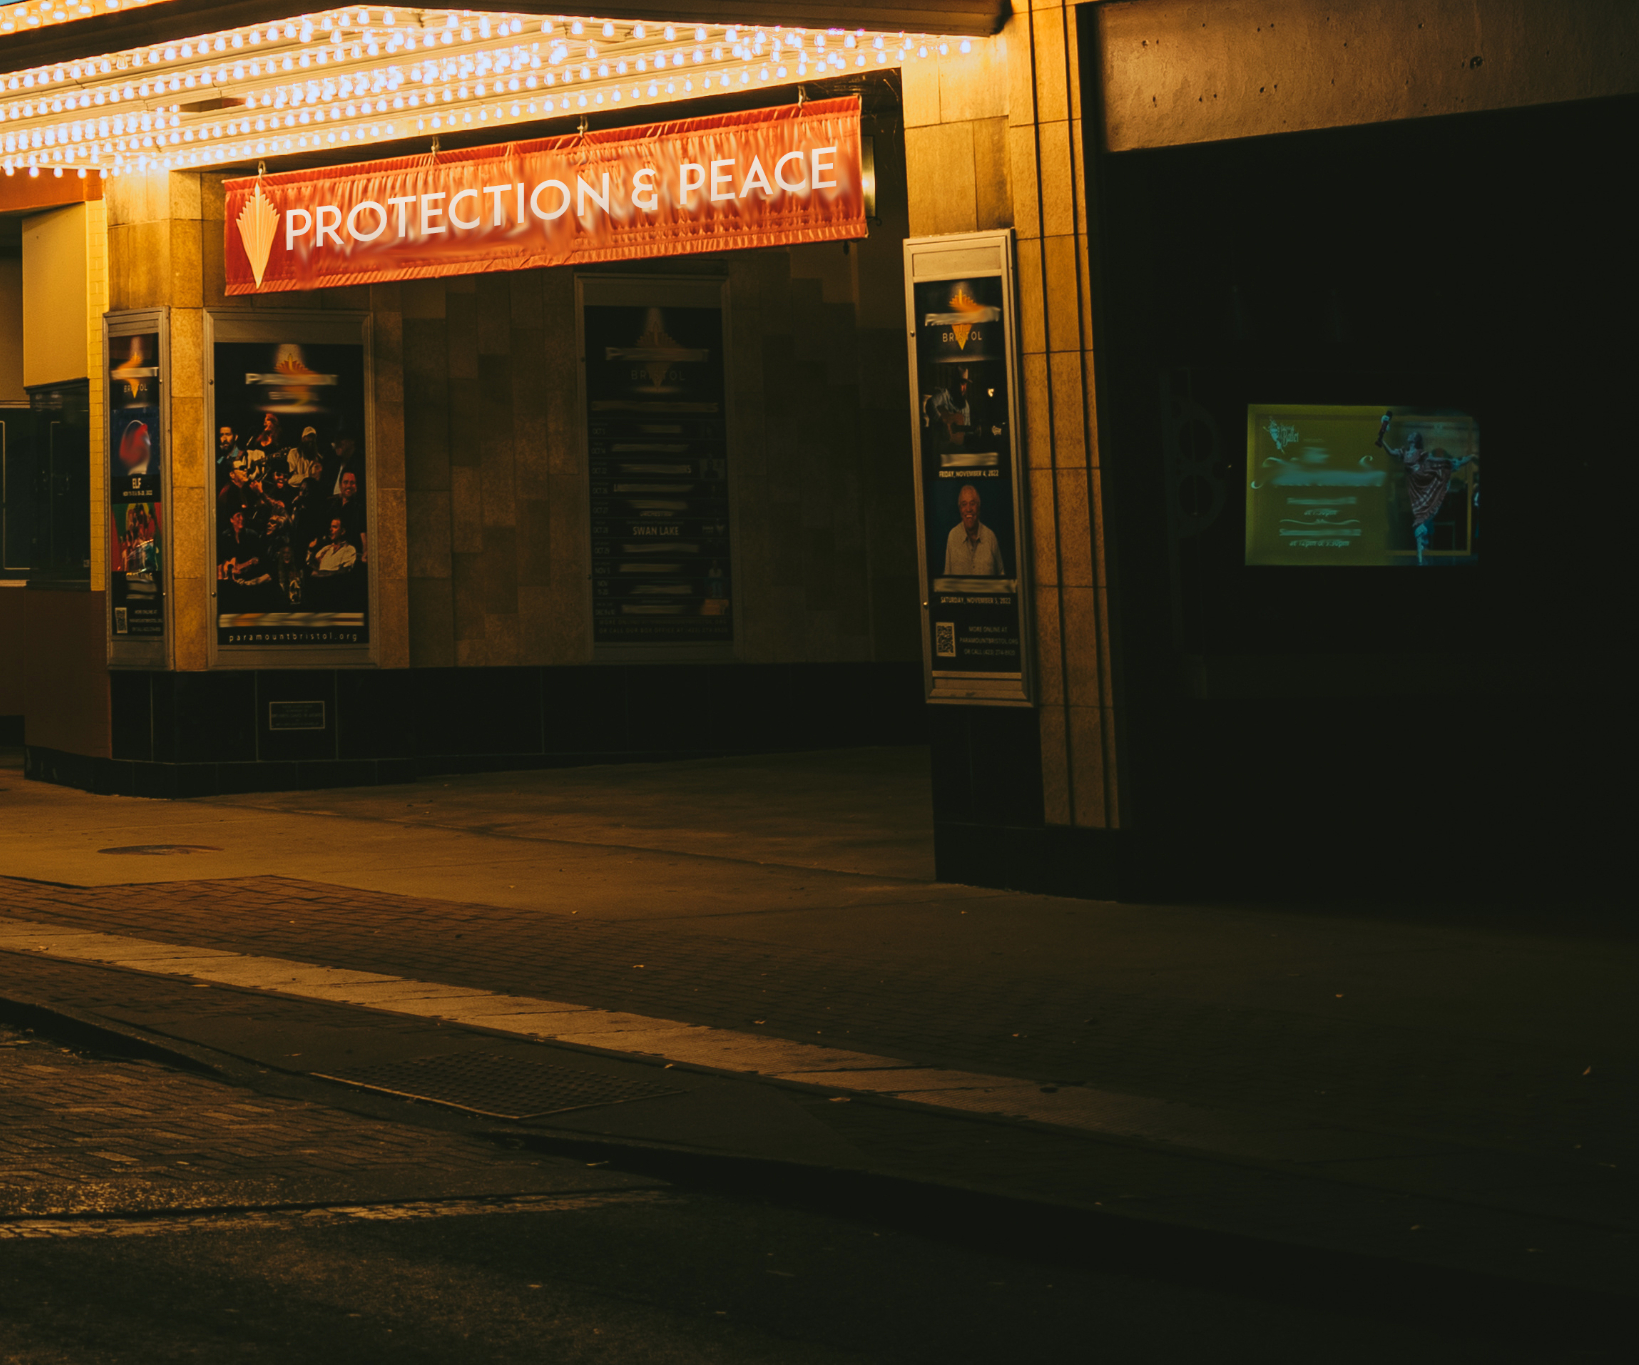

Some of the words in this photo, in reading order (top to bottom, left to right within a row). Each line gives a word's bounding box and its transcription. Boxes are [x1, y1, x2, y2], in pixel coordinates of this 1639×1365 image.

[285, 172, 610, 252] PROTECTION
[632, 169, 660, 211] &
[680, 147, 838, 209] PEACE
[632, 526, 657, 536] SWAN
[659, 526, 679, 536] LAKE
[229, 632, 357, 642] paramountbristol.org
